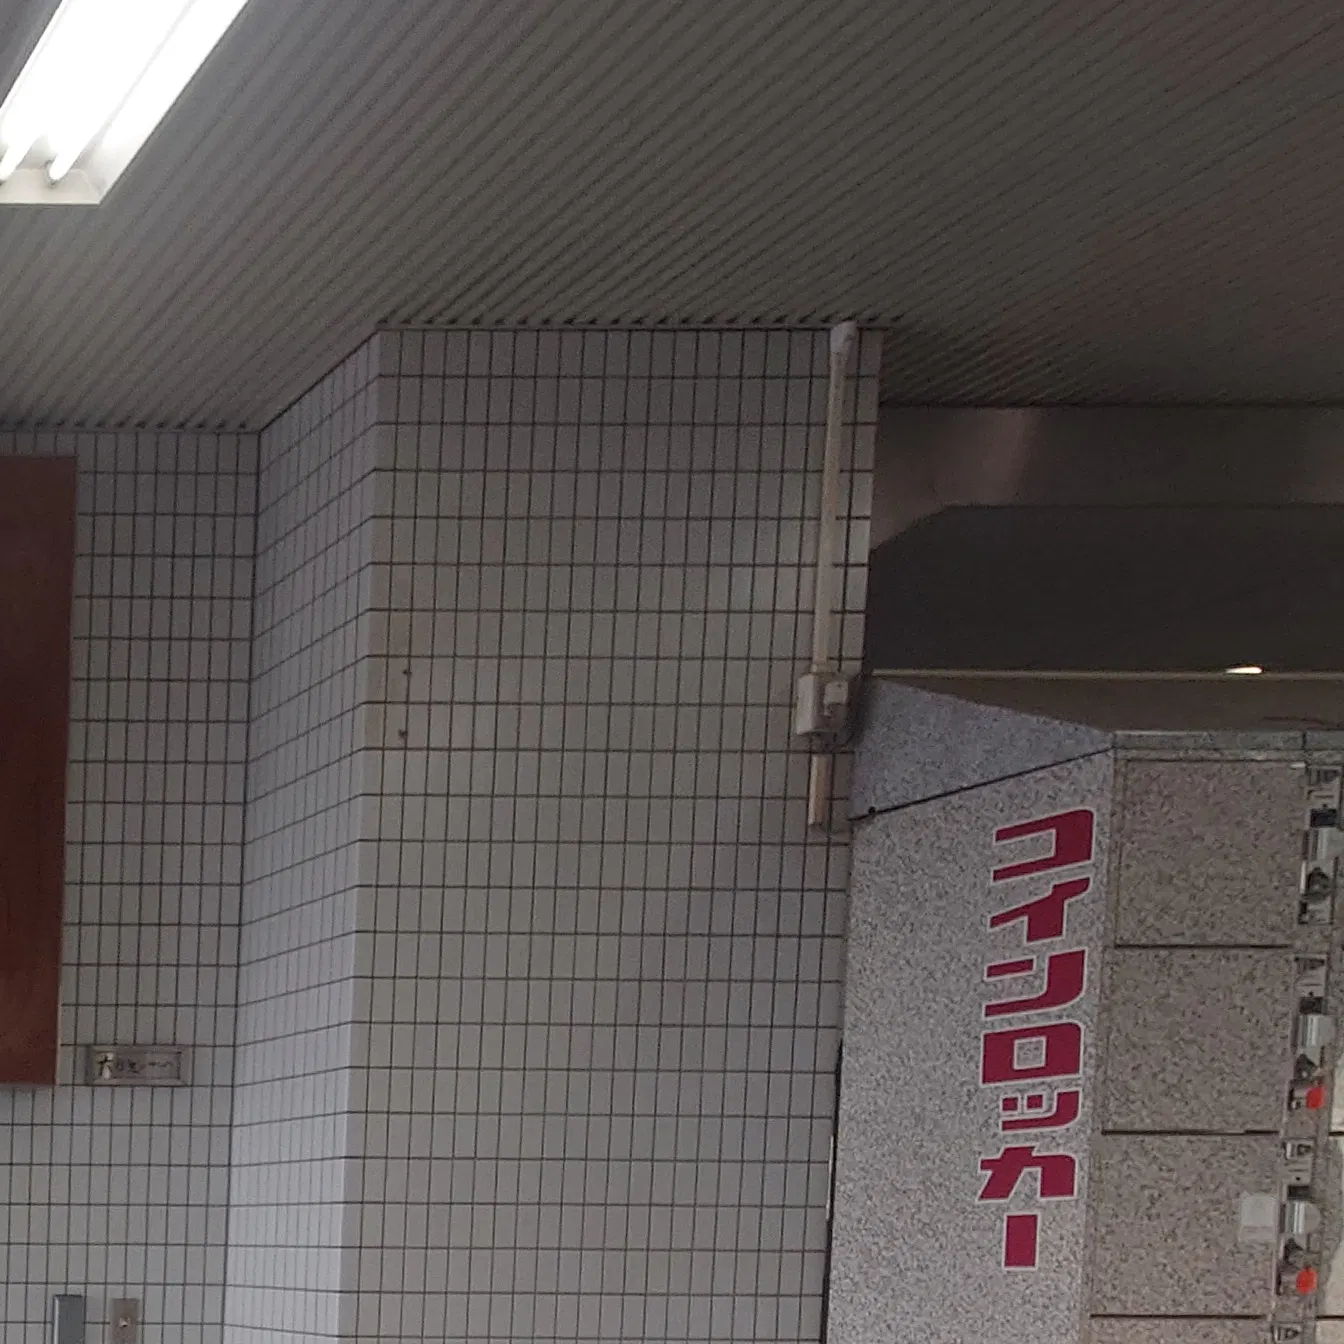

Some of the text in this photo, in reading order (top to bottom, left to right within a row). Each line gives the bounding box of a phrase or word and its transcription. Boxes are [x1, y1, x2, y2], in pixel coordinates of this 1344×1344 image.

[979, 808, 1095, 1270] コインロッカー
